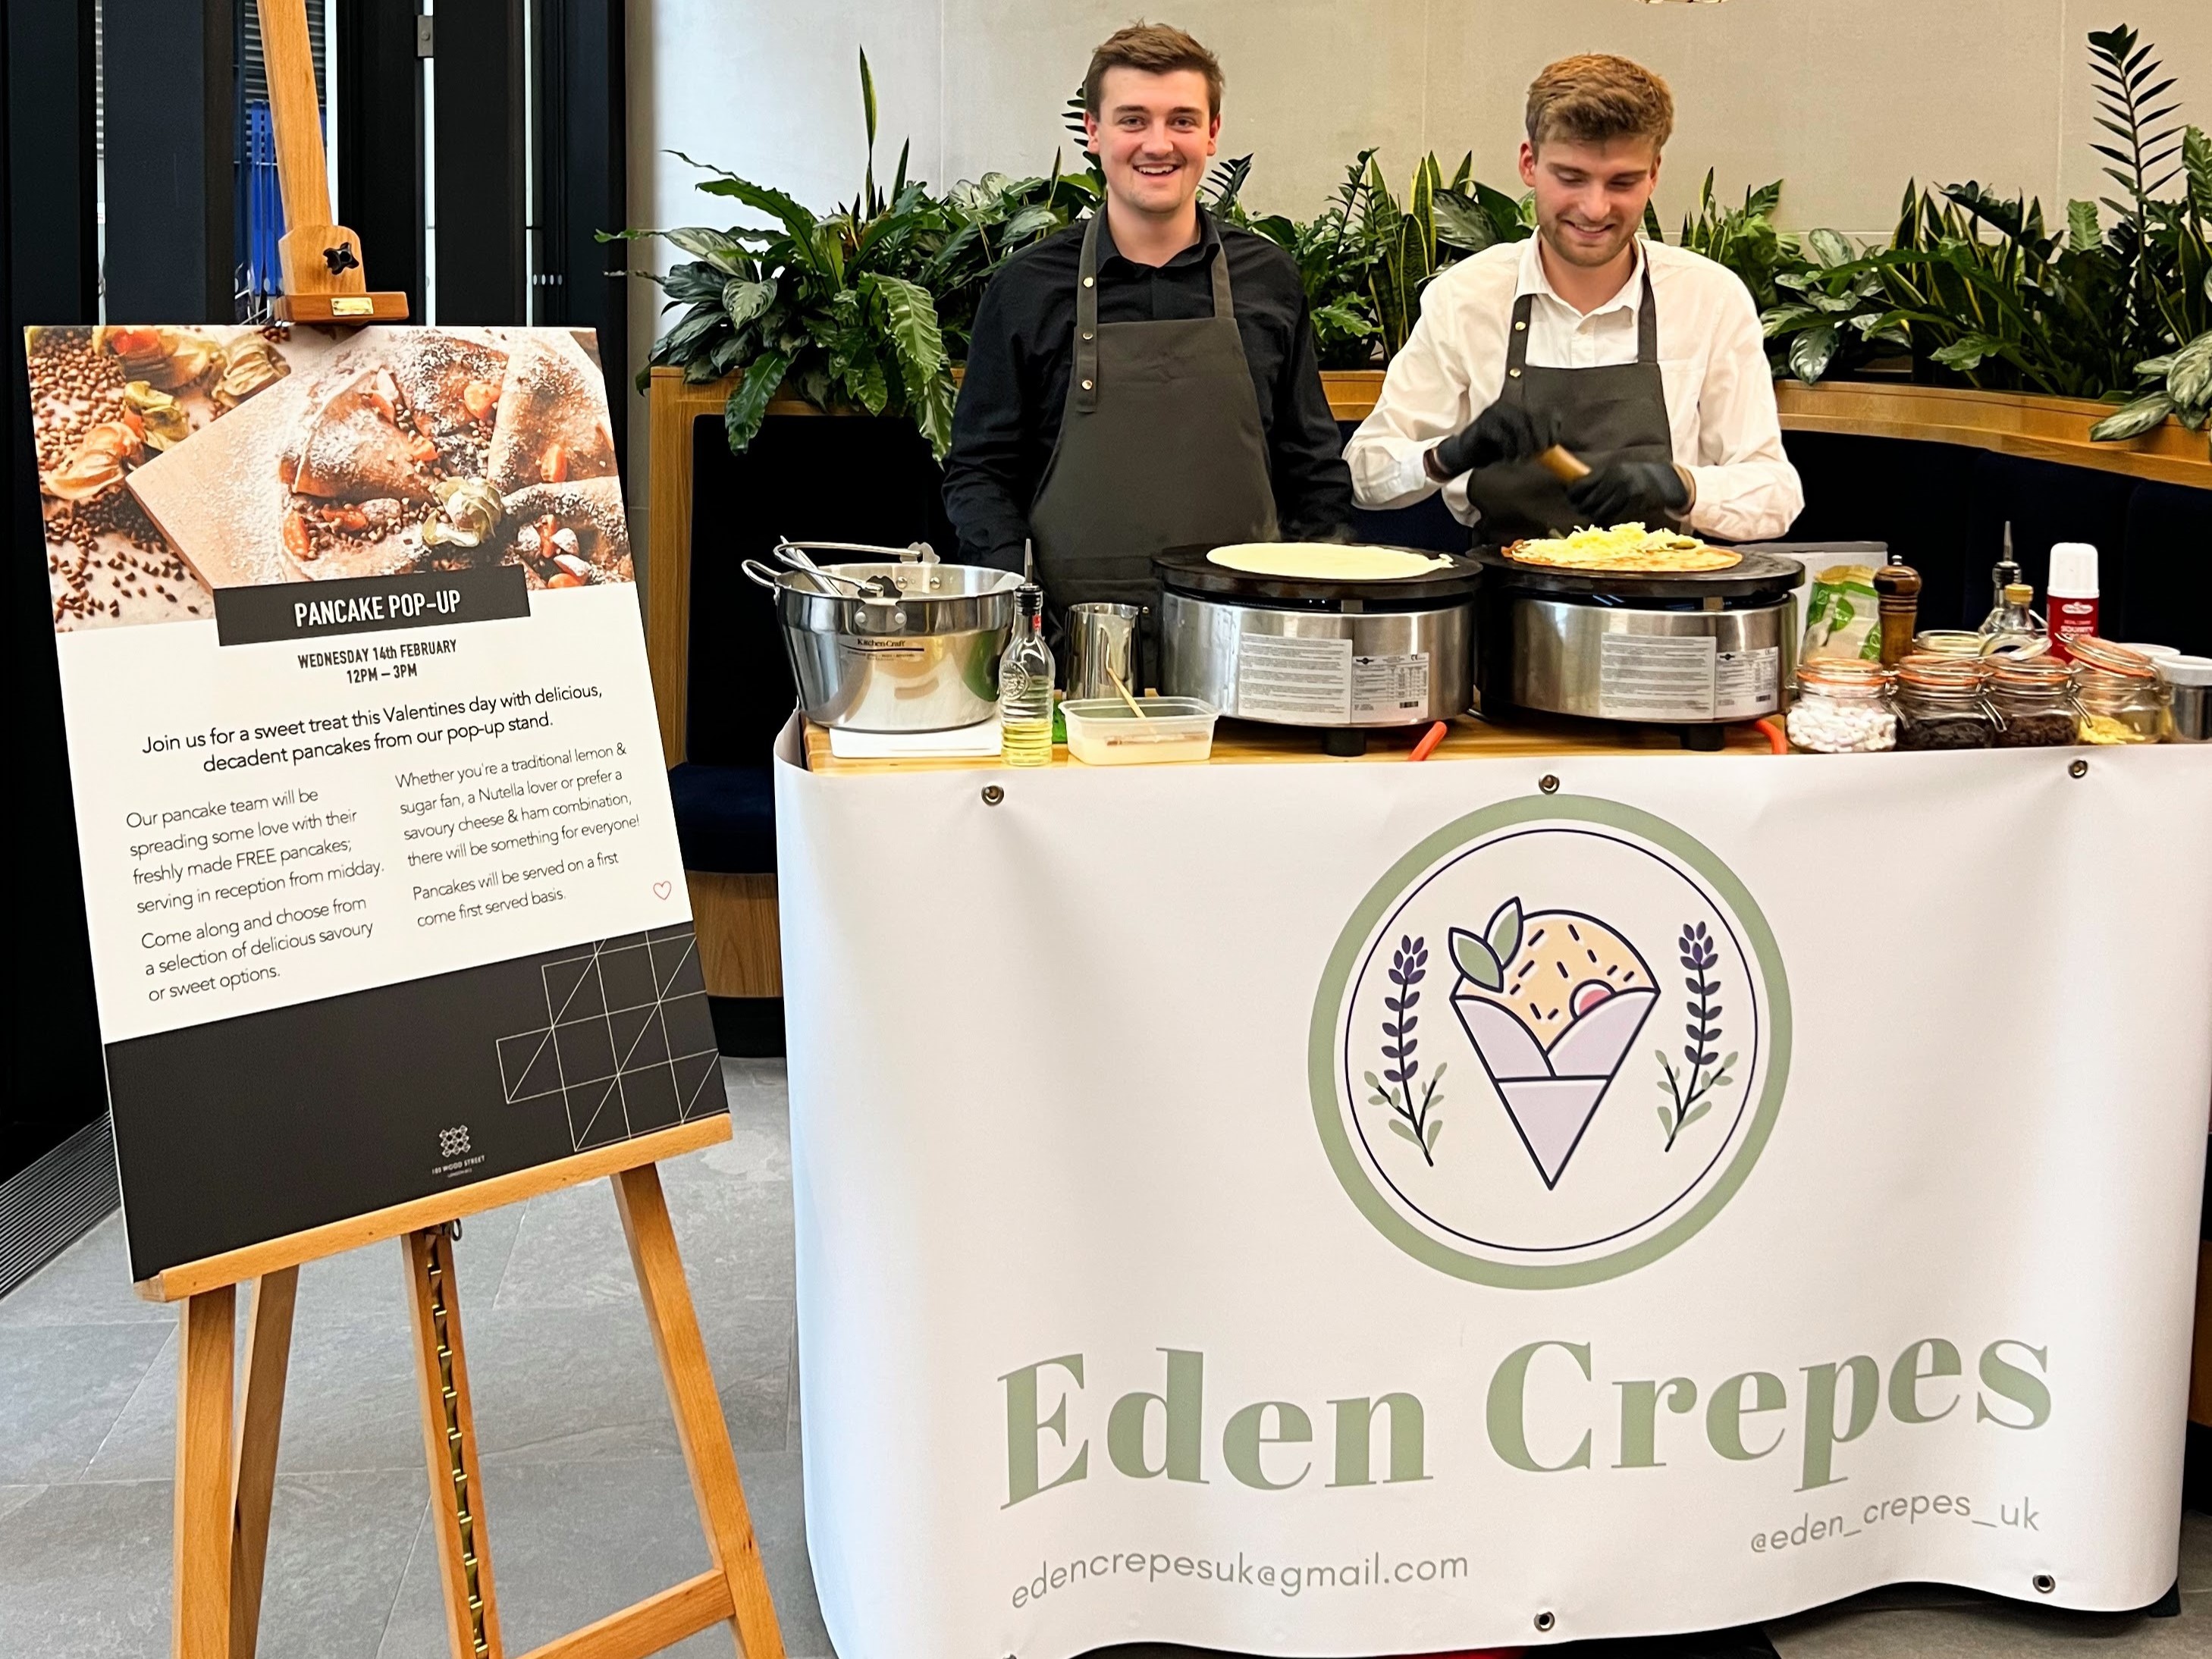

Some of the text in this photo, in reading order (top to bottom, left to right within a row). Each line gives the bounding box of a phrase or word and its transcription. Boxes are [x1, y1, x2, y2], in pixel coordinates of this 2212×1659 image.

[294, 589, 460, 627] PANCAKE POP-UP
[297, 638, 457, 669] WEDNESDAY 14th FEBRUARY
[347, 666, 378, 684] 12PM
[393, 663, 418, 679] 3PM
[142, 685, 602, 754] Join us for a sweet treat this Valentines day with delicious,
[203, 710, 554, 773] decadent pancakes from our pop-up stand.
[394, 742, 627, 789] Whether you're a traditional lemon &
[126, 788, 318, 829] Our pancake team will be
[400, 769, 623, 817] sugar fan, a Nutella lover or prefer a
[130, 811, 357, 861] spreading some love with their
[403, 795, 632, 841] savoury cheese & ham combination,
[407, 814, 639, 867] there will be something for everyone!
[133, 839, 352, 885] freshly made FREE pancakes;
[413, 851, 620, 901] Pancakes will be served on a first
[136, 860, 384, 914] serving in reception from midday.
[417, 890, 566, 927] come first served basis.
[141, 898, 367, 949] Come along and choose from
[146, 923, 373, 976] a selection of delicious savoury
[149, 967, 281, 1002] or sweet options.
[443, 1162, 463, 1171] WOOD
[464, 1155, 485, 1166] STREET
[998, 1338, 2052, 1510] Eden Crepes
[1751, 1494, 2039, 1554] @eden_crepes_uk
[1013, 1552, 1469, 1609] edencrepesuk@gmail.com
